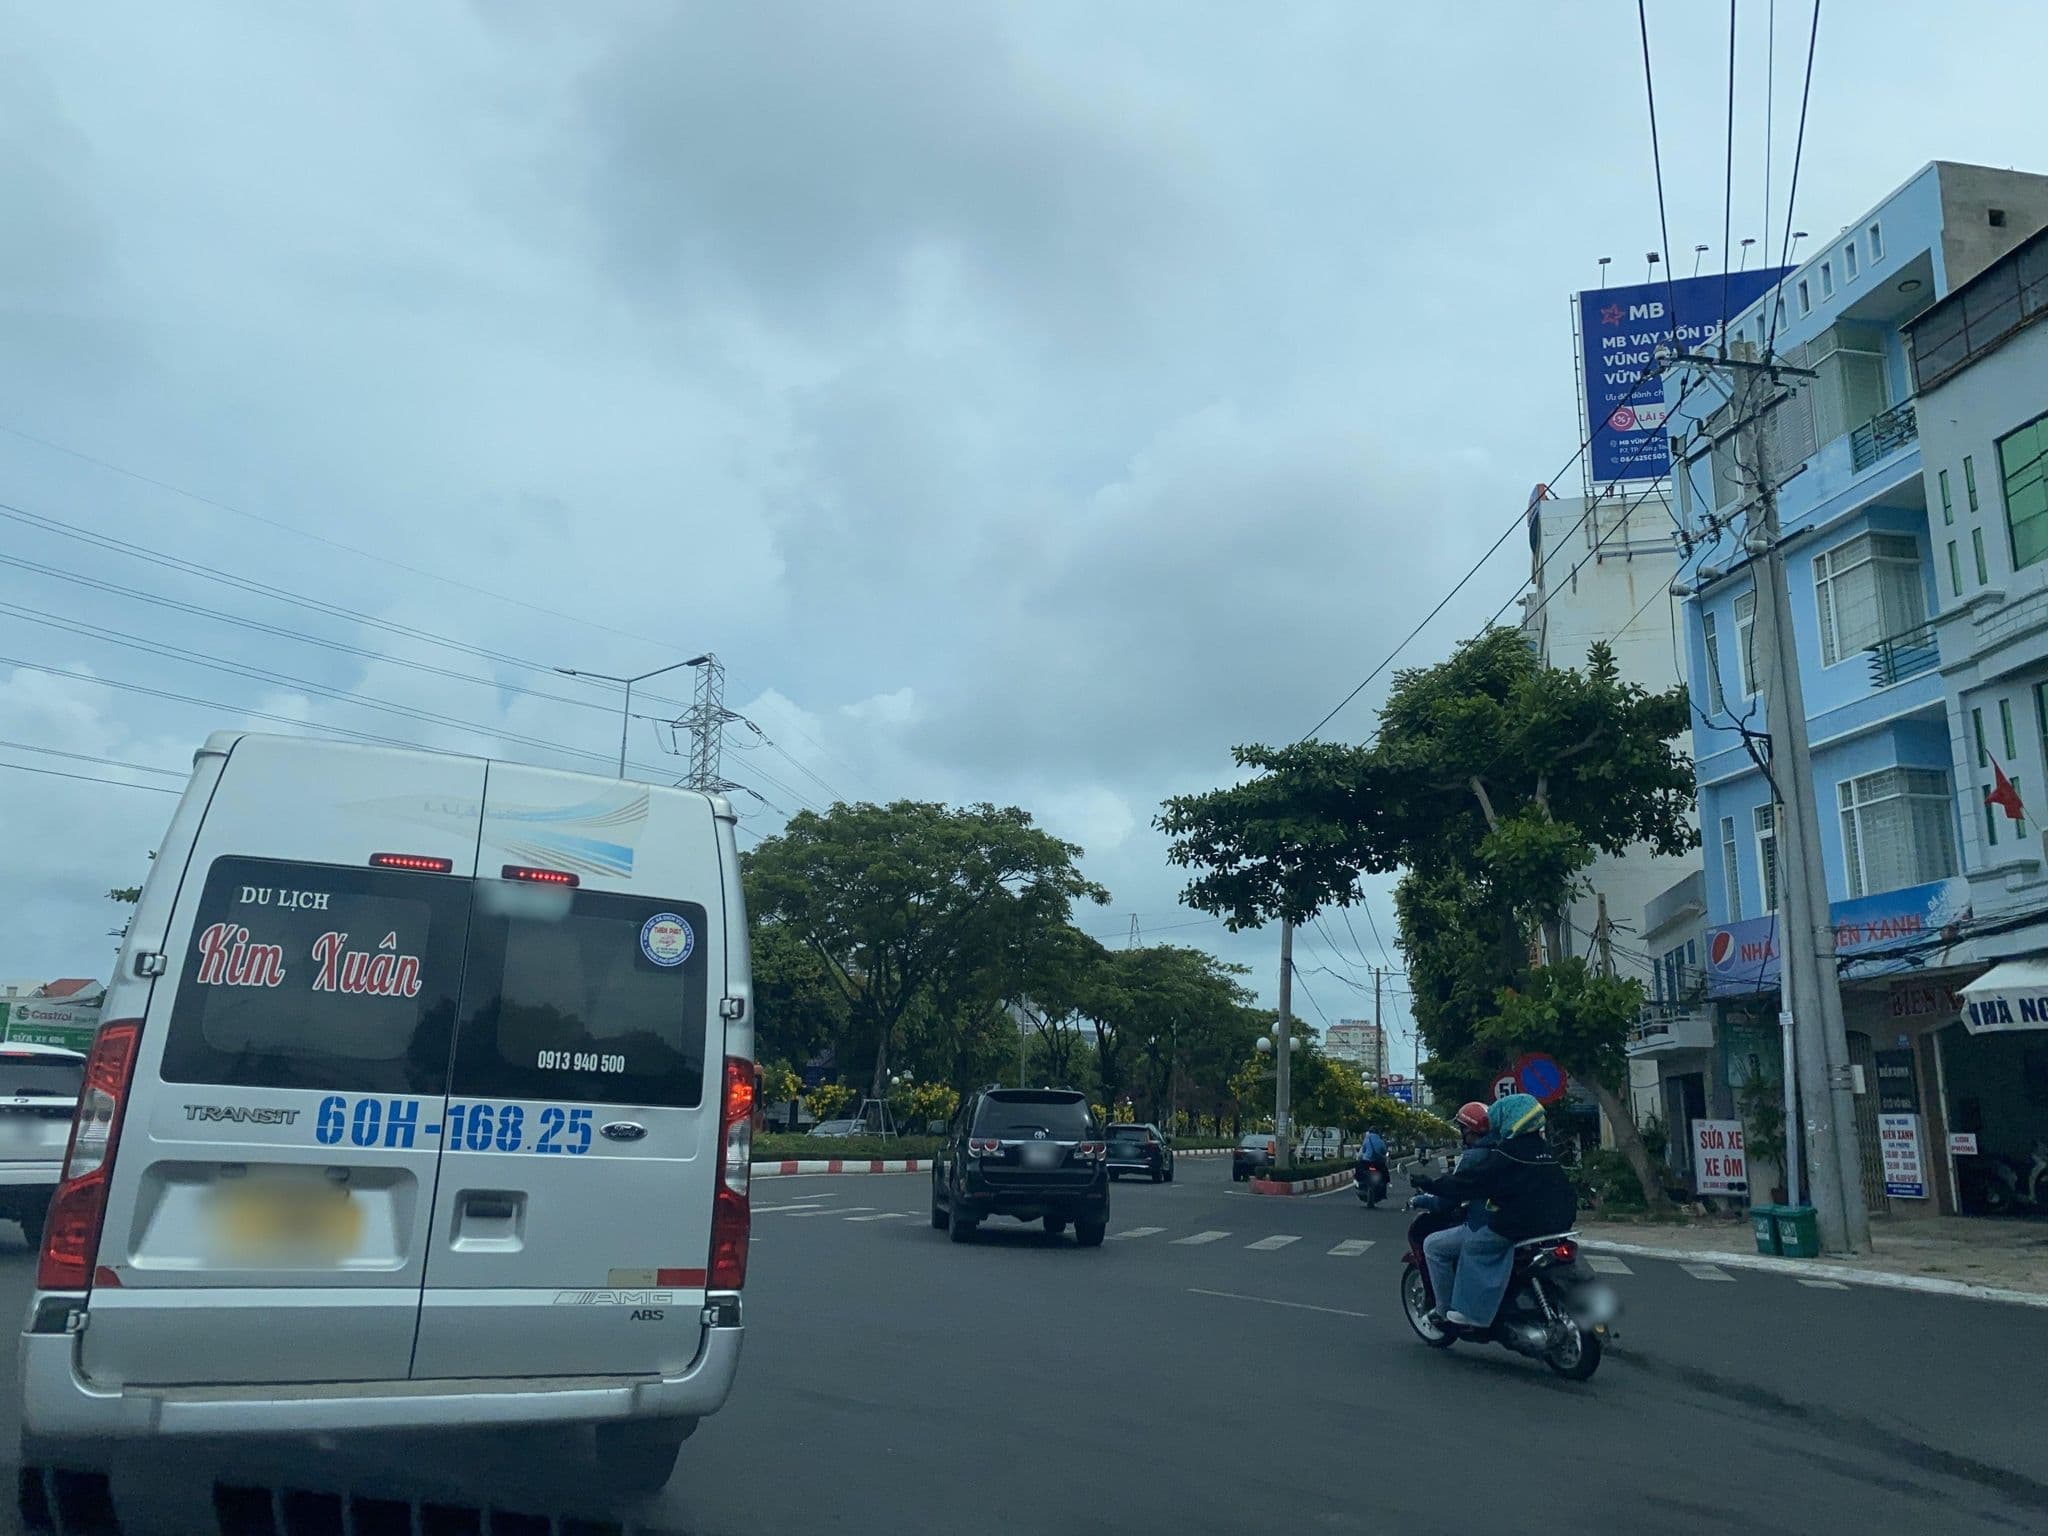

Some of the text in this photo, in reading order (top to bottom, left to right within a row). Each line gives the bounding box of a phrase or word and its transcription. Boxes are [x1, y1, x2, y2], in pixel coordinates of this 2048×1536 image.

[1629, 302, 1665, 321] MB
[1602, 336, 1627, 349] MB
[1630, 332, 1660, 347] VAY
[1603, 351, 1650, 367] VŨNG
[240, 886, 330, 911] DU LỊCH
[1741, 934, 1775, 962] NHÀ
[1867, 912, 1921, 942] XANH
[197, 922, 421, 998] Kim Xuân
[31, 1009, 72, 1021] Castrol
[538, 1050, 625, 1073] 0913 940 500
[183, 1104, 301, 1125] TRANSIT
[316, 1096, 592, 1154] 60H-168.25
[1701, 1125, 1743, 1149] SỬA XE
[1705, 1154, 1743, 1176] XE ÔM
[590, 1291, 673, 1304] AMG
[630, 1310, 664, 1321] ABS
